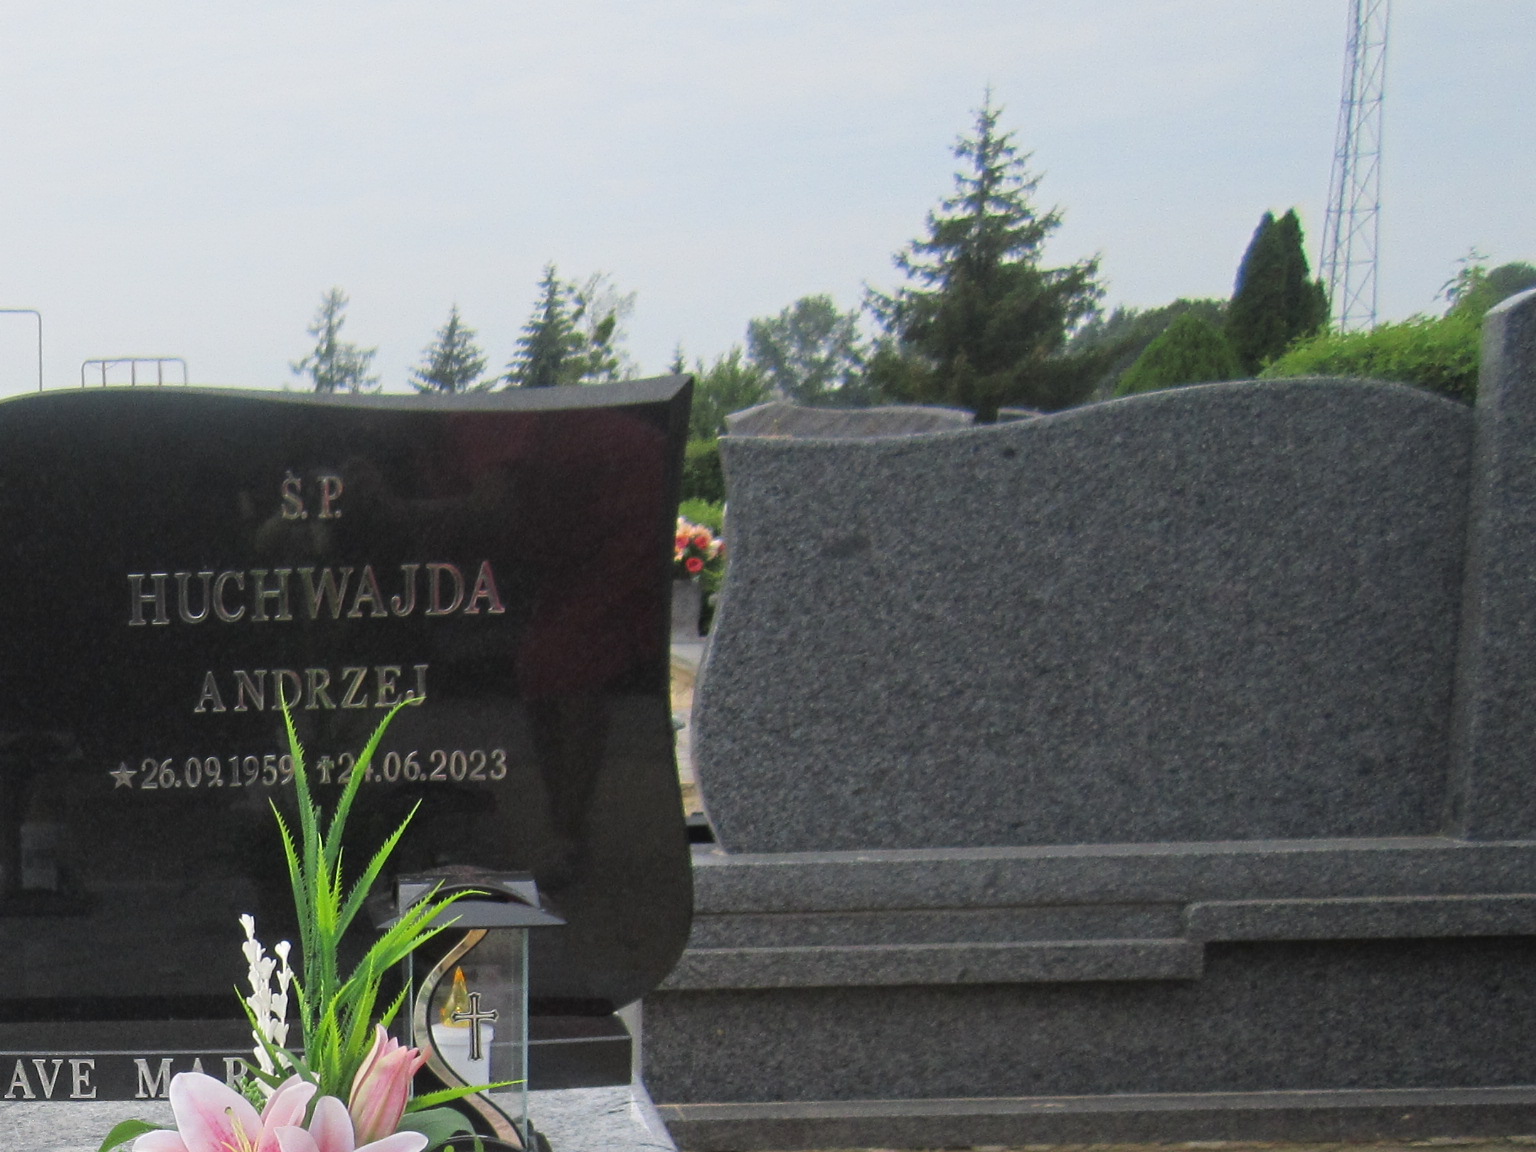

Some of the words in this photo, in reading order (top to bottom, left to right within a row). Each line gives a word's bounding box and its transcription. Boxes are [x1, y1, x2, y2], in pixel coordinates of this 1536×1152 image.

[126, 559, 507, 627] HUCHWAJDA
[193, 663, 430, 713] ANDRZEJ
[140, 753, 296, 790] 26.09.1959
[4, 1057, 98, 1099] AVE
